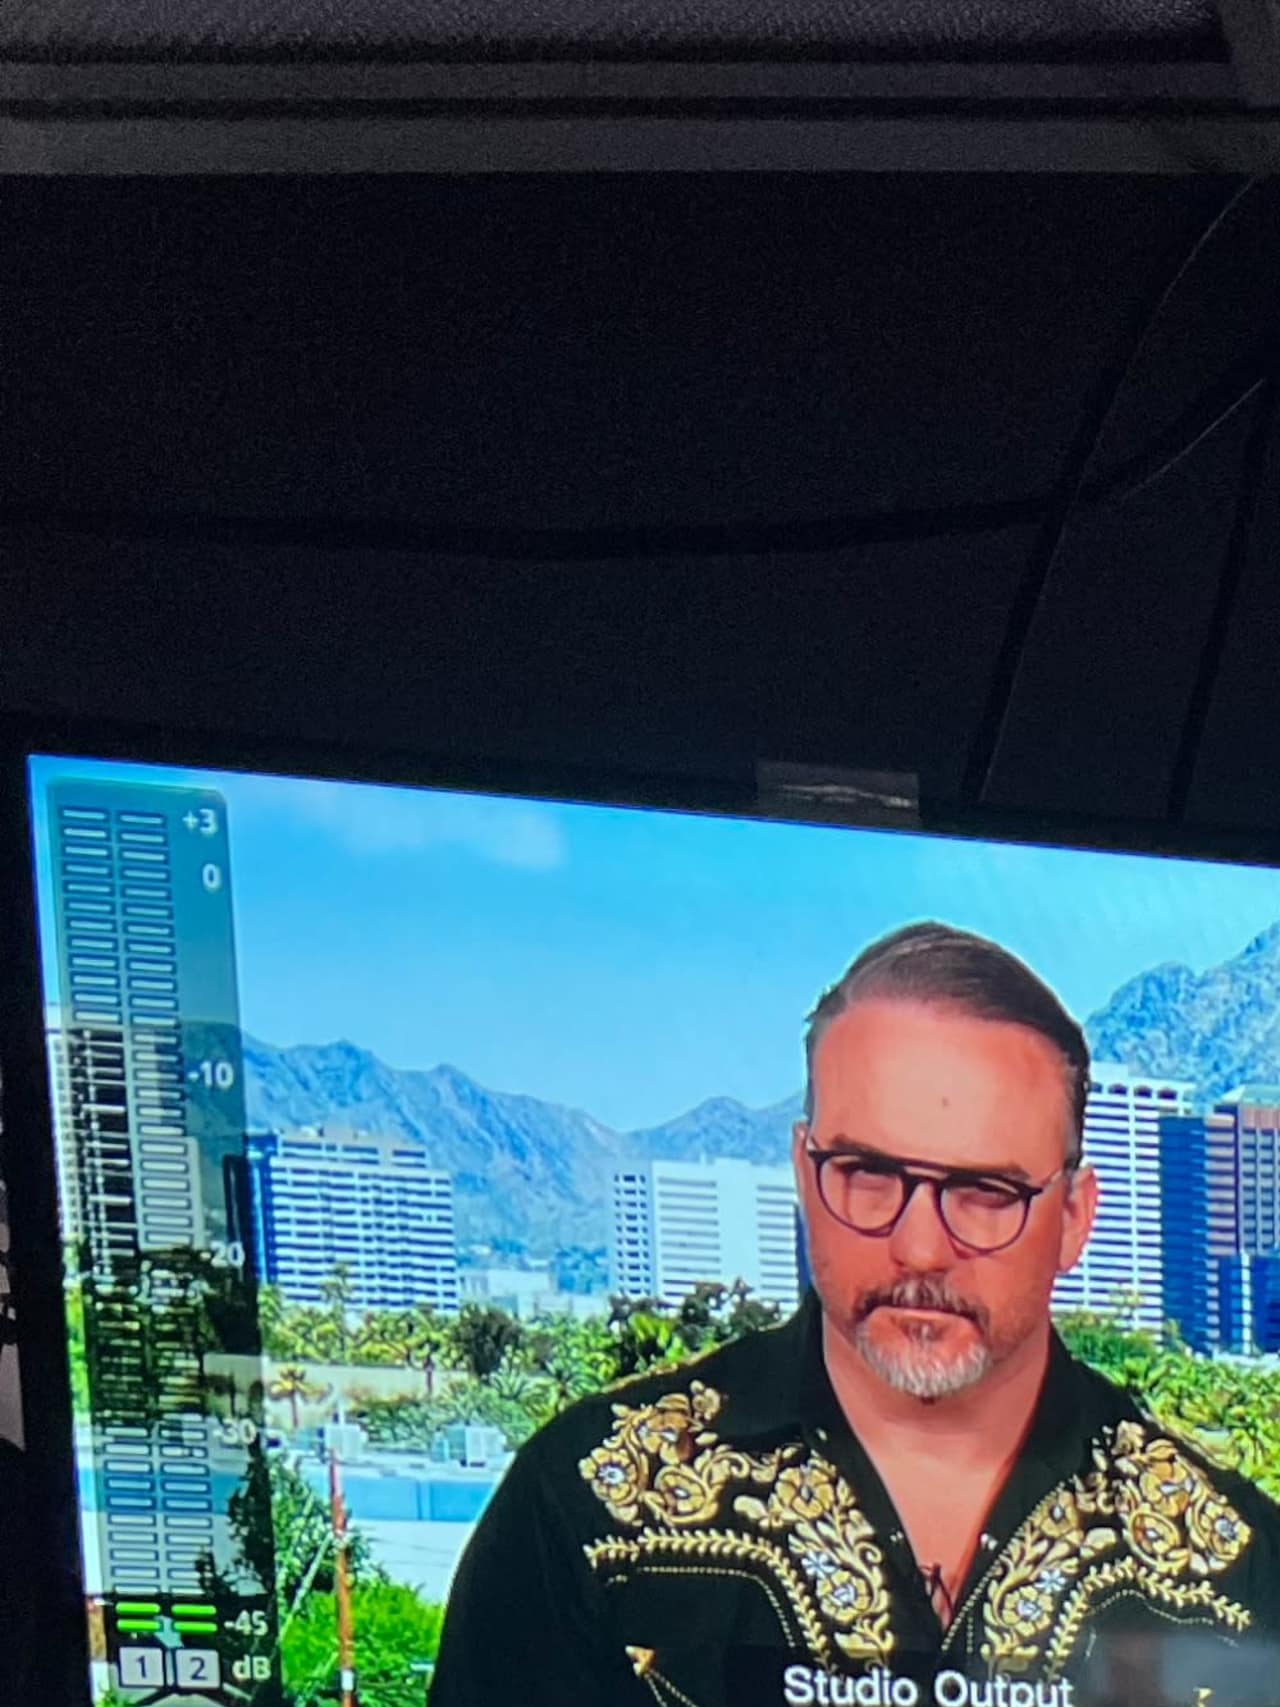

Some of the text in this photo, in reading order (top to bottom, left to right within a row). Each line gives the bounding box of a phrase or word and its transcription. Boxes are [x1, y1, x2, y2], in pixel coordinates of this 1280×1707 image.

[183, 809, 217, 834] +3
[204, 866, 220, 889] 0
[188, 1062, 234, 1088] -10
[202, 1240, 245, 1266] -20
[225, 1611, 268, 1636] -45
[190, 1655, 208, 1680] 2
[233, 1655, 272, 1681] dB
